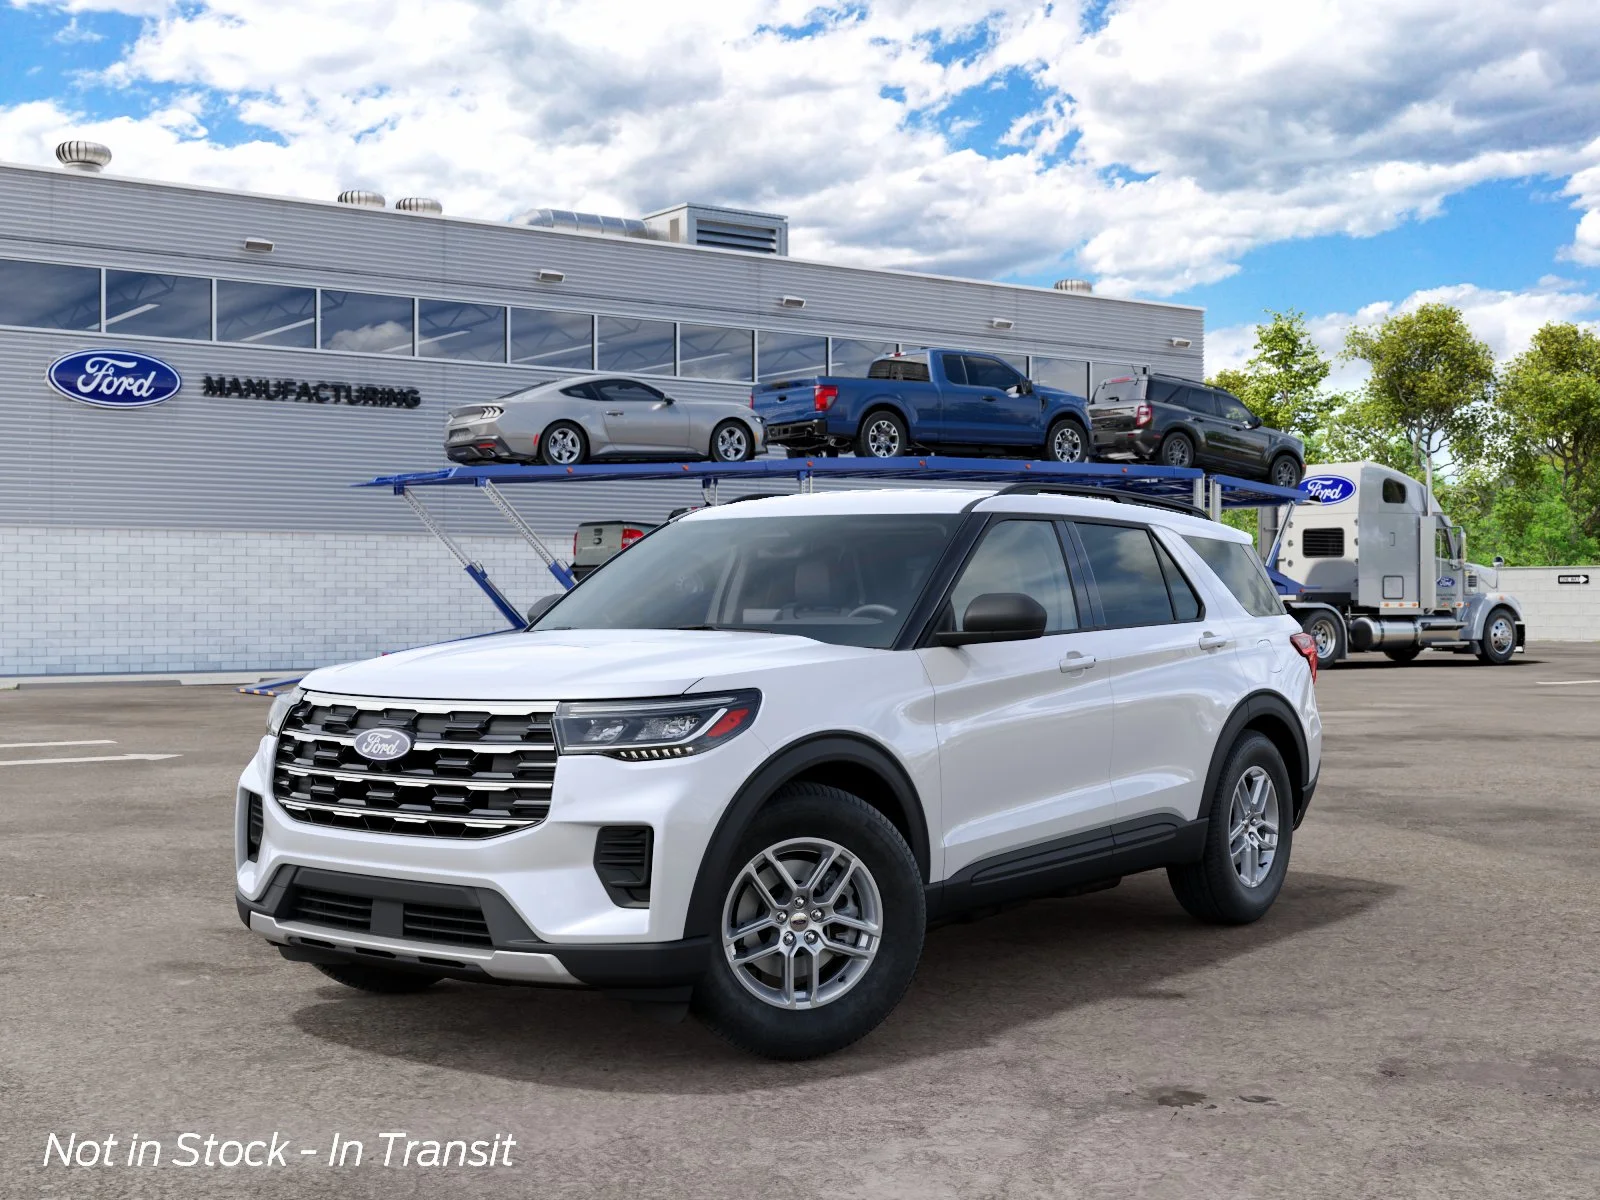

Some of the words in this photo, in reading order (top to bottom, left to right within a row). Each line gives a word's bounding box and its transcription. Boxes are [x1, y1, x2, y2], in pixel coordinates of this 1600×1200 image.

[77, 357, 156, 397] Ford
[203, 373, 421, 409] MANUFACTURING
[1306, 480, 1343, 500] Ford
[362, 733, 399, 755] Ford
